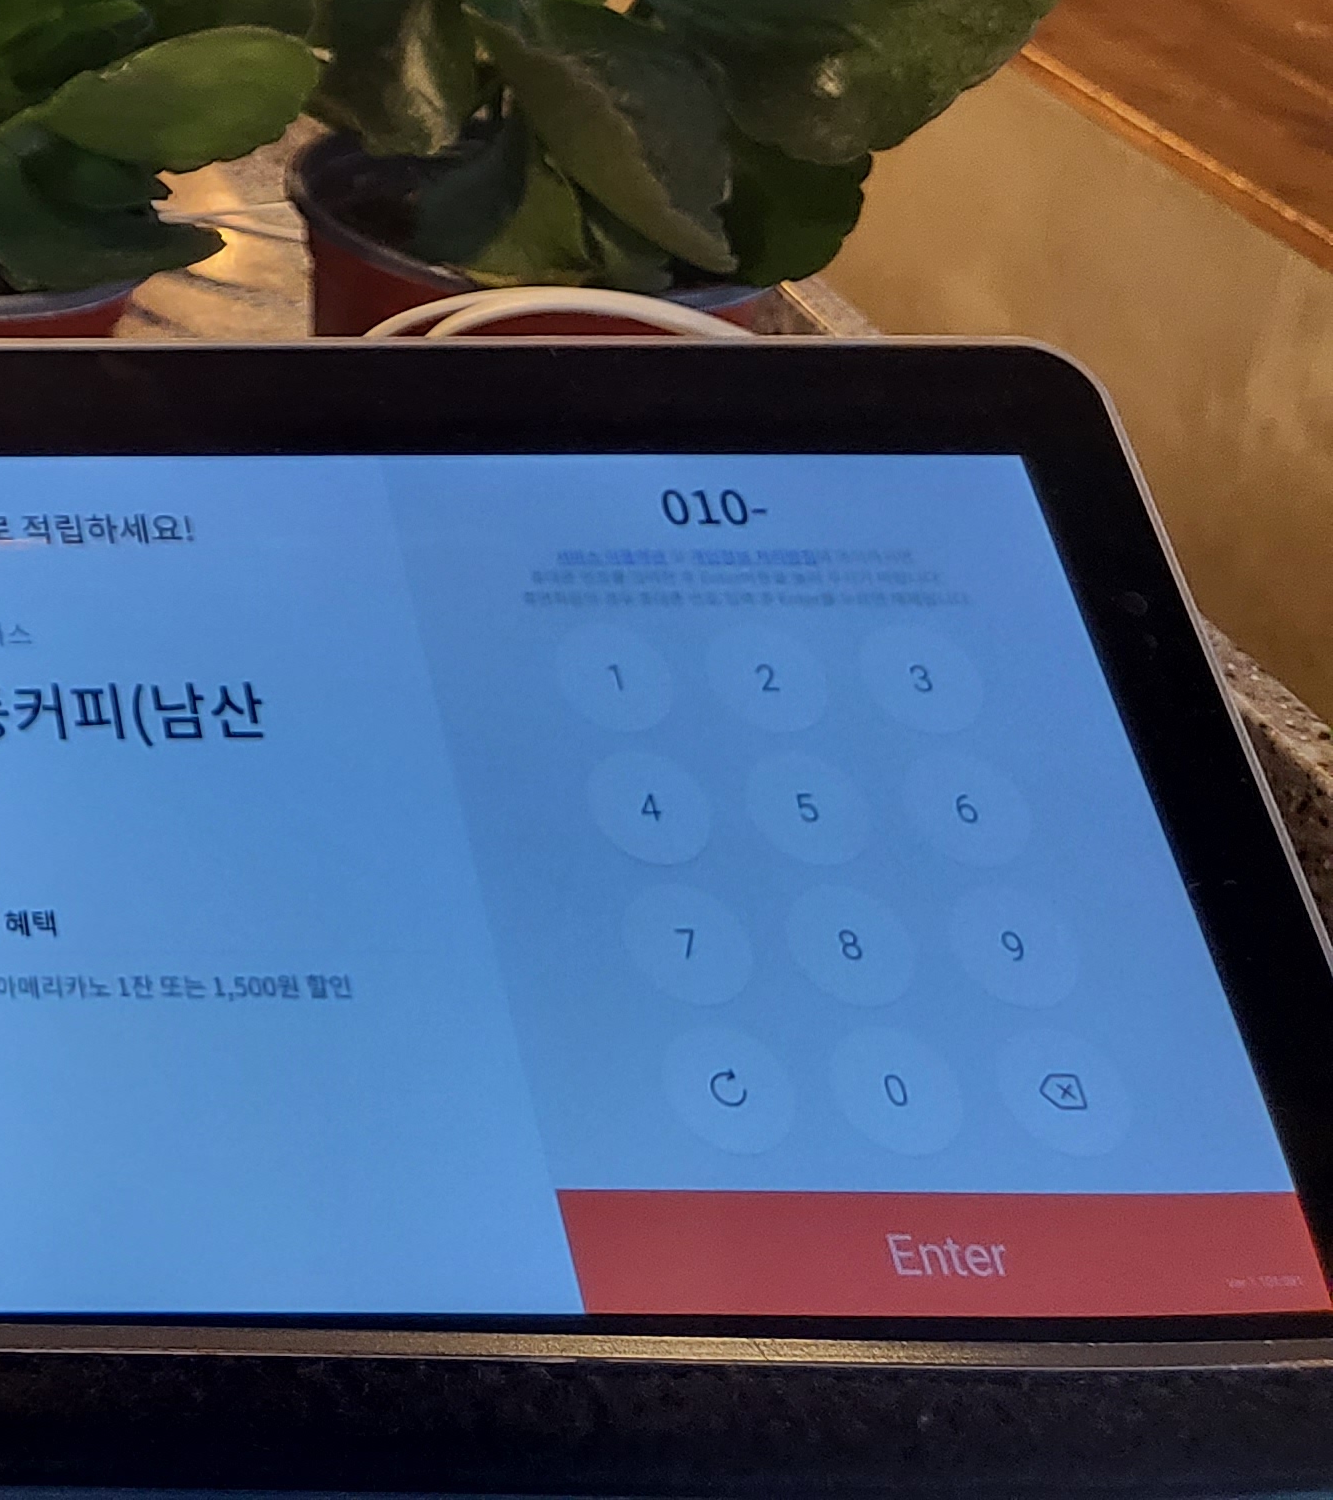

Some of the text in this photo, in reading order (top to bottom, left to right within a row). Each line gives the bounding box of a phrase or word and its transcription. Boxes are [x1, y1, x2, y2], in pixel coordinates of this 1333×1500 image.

[23, 514, 196, 545] 적립하세요!
[607, 664, 624, 693] 1
[755, 664, 781, 693] 2
[909, 664, 933, 693] 3
[640, 794, 662, 823] 4
[796, 794, 820, 823] 5
[955, 794, 979, 825] 6
[673, 929, 695, 959] 7
[839, 929, 863, 961] 8
[1000, 930, 1025, 961] 9
[118, 974, 155, 1000] 1잔
[160, 974, 207, 1000] 또는
[213, 974, 300, 1002] 1,500원
[306, 974, 353, 1000] 할인
[884, 1074, 908, 1108] 0
[886, 1233, 1006, 1279] Enter
